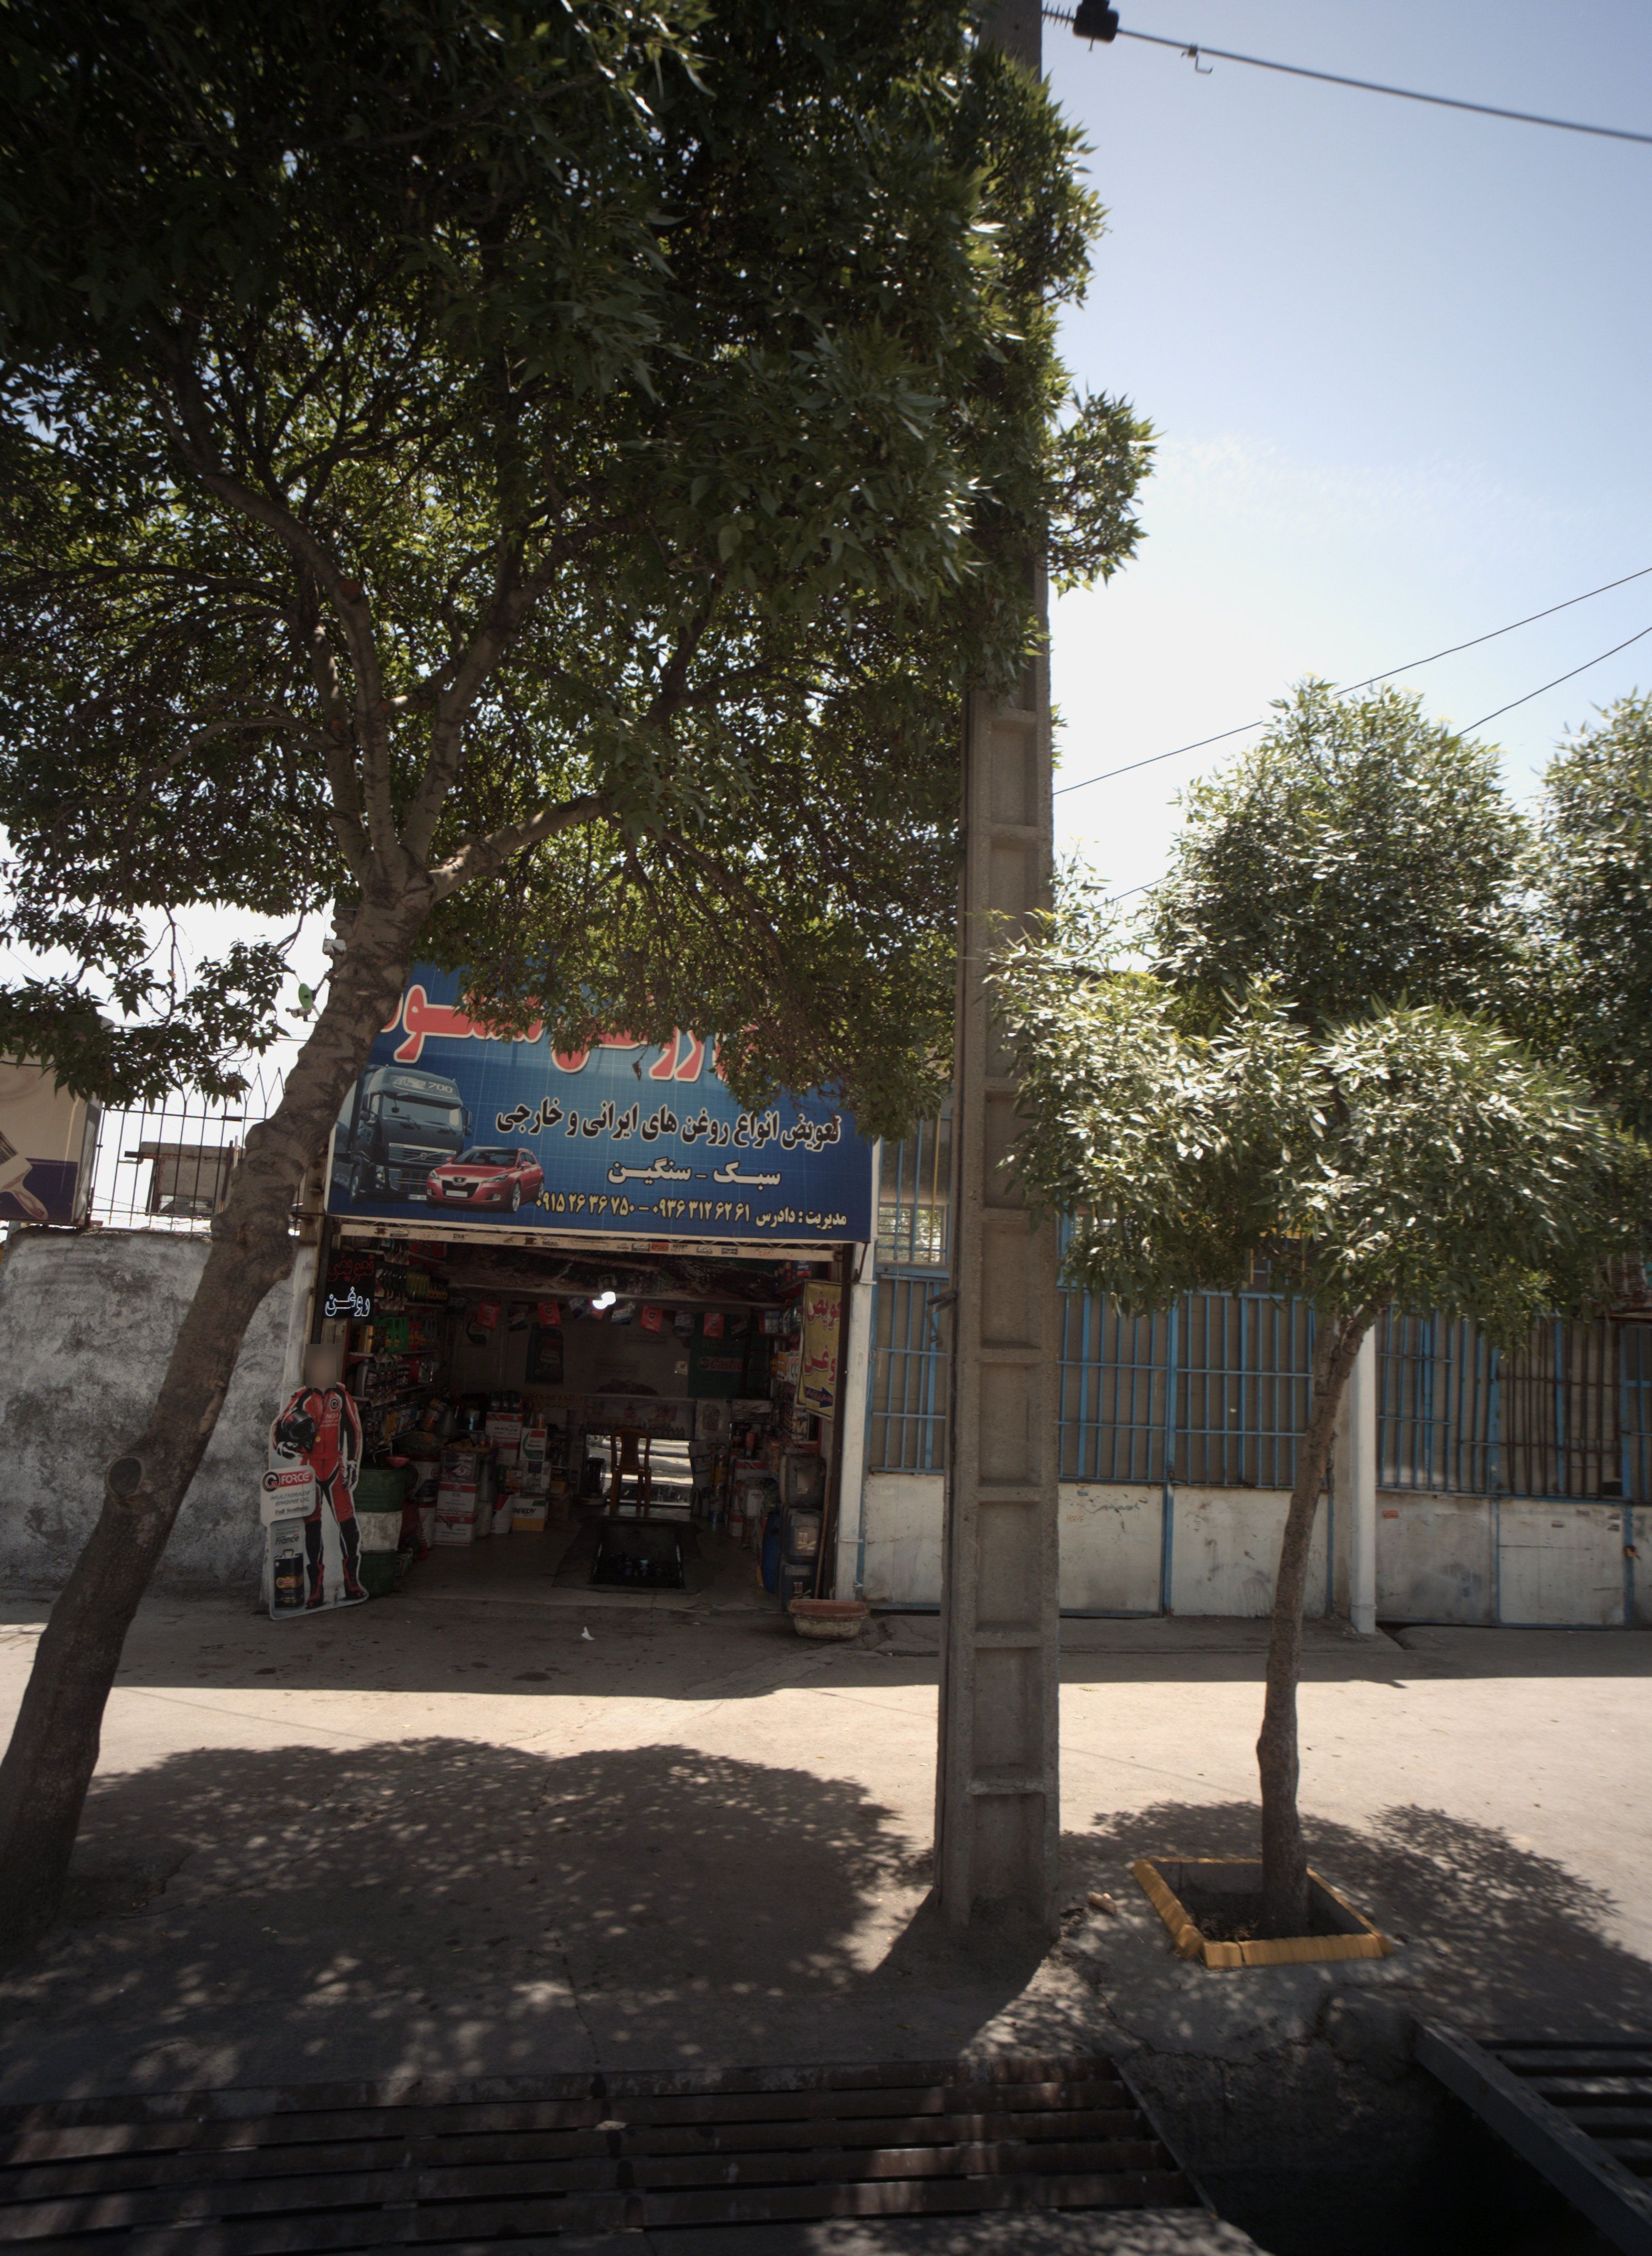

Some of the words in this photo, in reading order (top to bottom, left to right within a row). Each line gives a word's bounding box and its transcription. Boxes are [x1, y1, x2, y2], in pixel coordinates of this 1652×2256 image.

[428, 1082, 453, 1093] 700
[496, 1095, 564, 1135] خارجی
[565, 1110, 579, 1137] و
[582, 1100, 639, 1140] ایرانی
[640, 1104, 678, 1142] های
[681, 1107, 730, 1147] روغن
[732, 1109, 780, 1148] انواع
[607, 1157, 691, 1184] سنگین
[713, 1160, 781, 1191] سبک
[756, 1206, 796, 1228] دادرس
[805, 1210, 847, 1229] مدیریت
[326, 1252, 375, 1283] تعویض
[325, 1286, 371, 1317] روغن
[281, 1472, 310, 1485] FORCE
[275, 1536, 300, 1545] France
